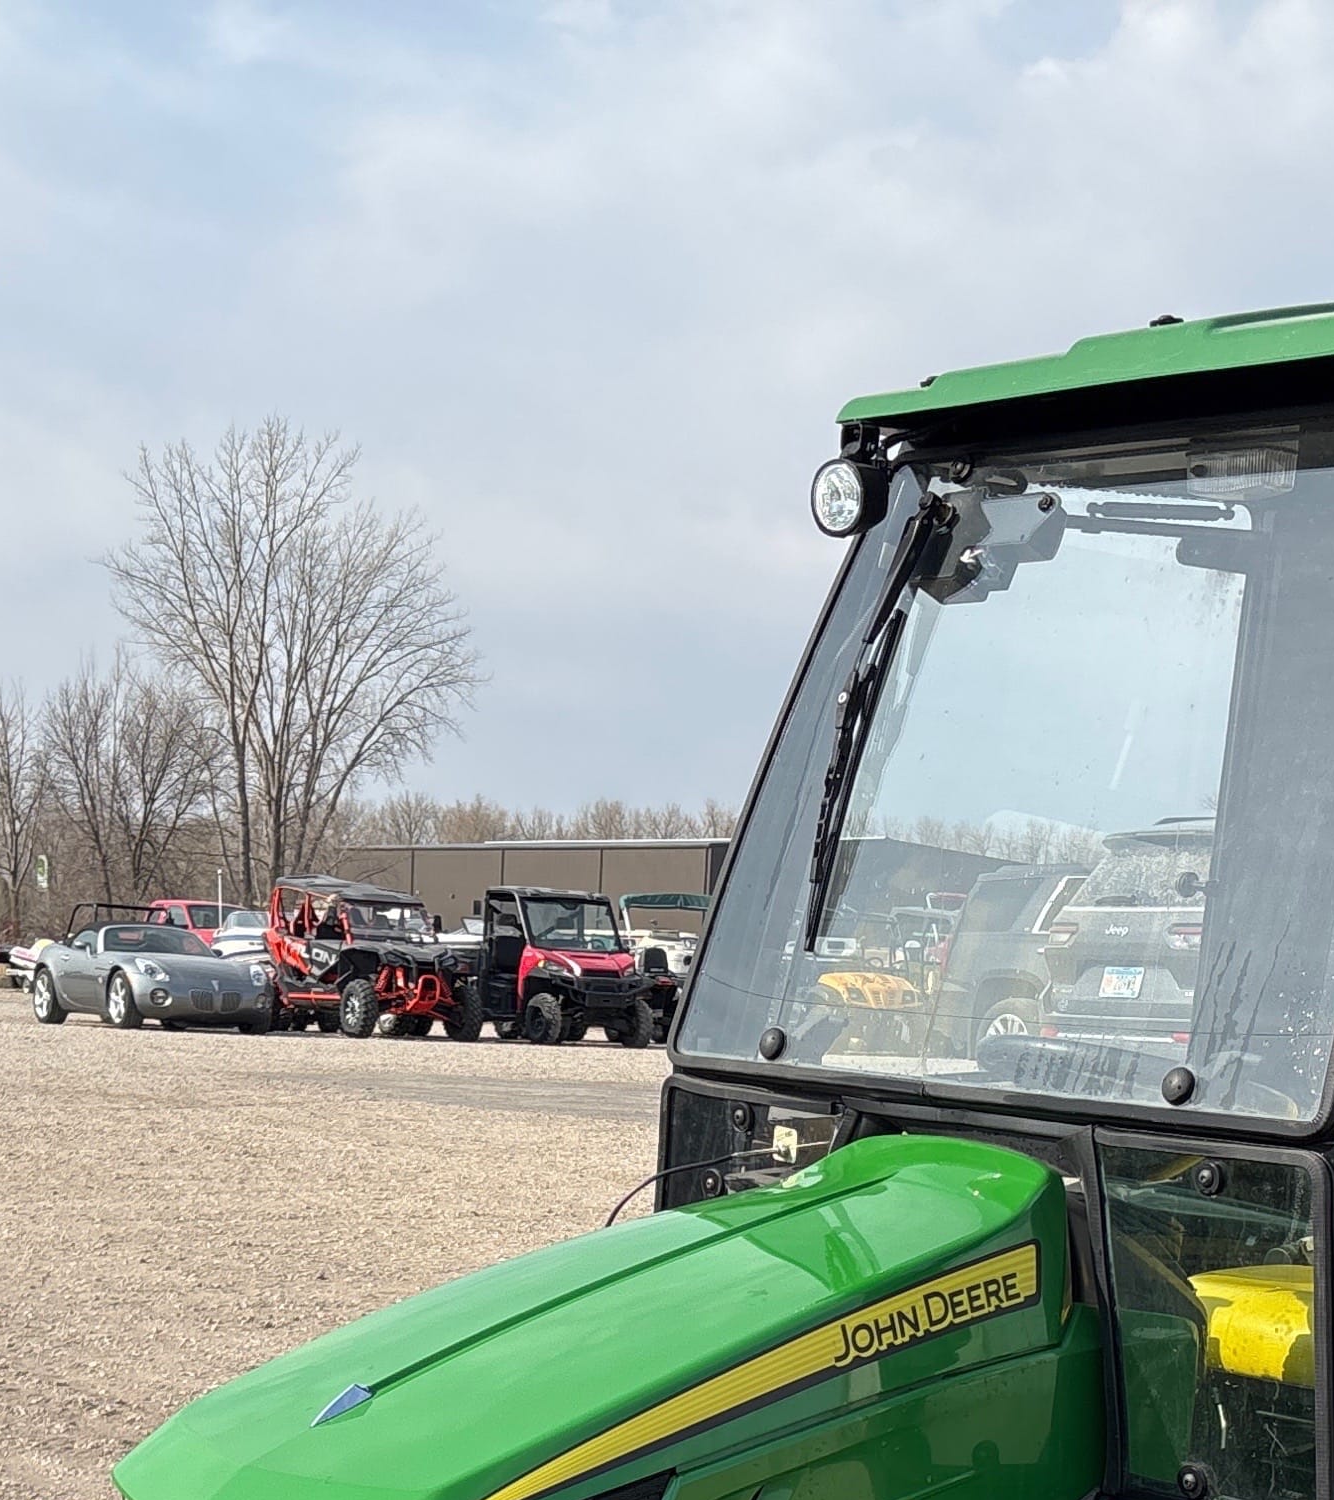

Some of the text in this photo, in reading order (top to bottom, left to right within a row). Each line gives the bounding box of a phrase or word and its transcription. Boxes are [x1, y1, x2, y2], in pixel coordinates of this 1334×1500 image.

[1105, 924, 1129, 937] Jeep
[833, 1272, 1021, 1363] JOHN DEERE
